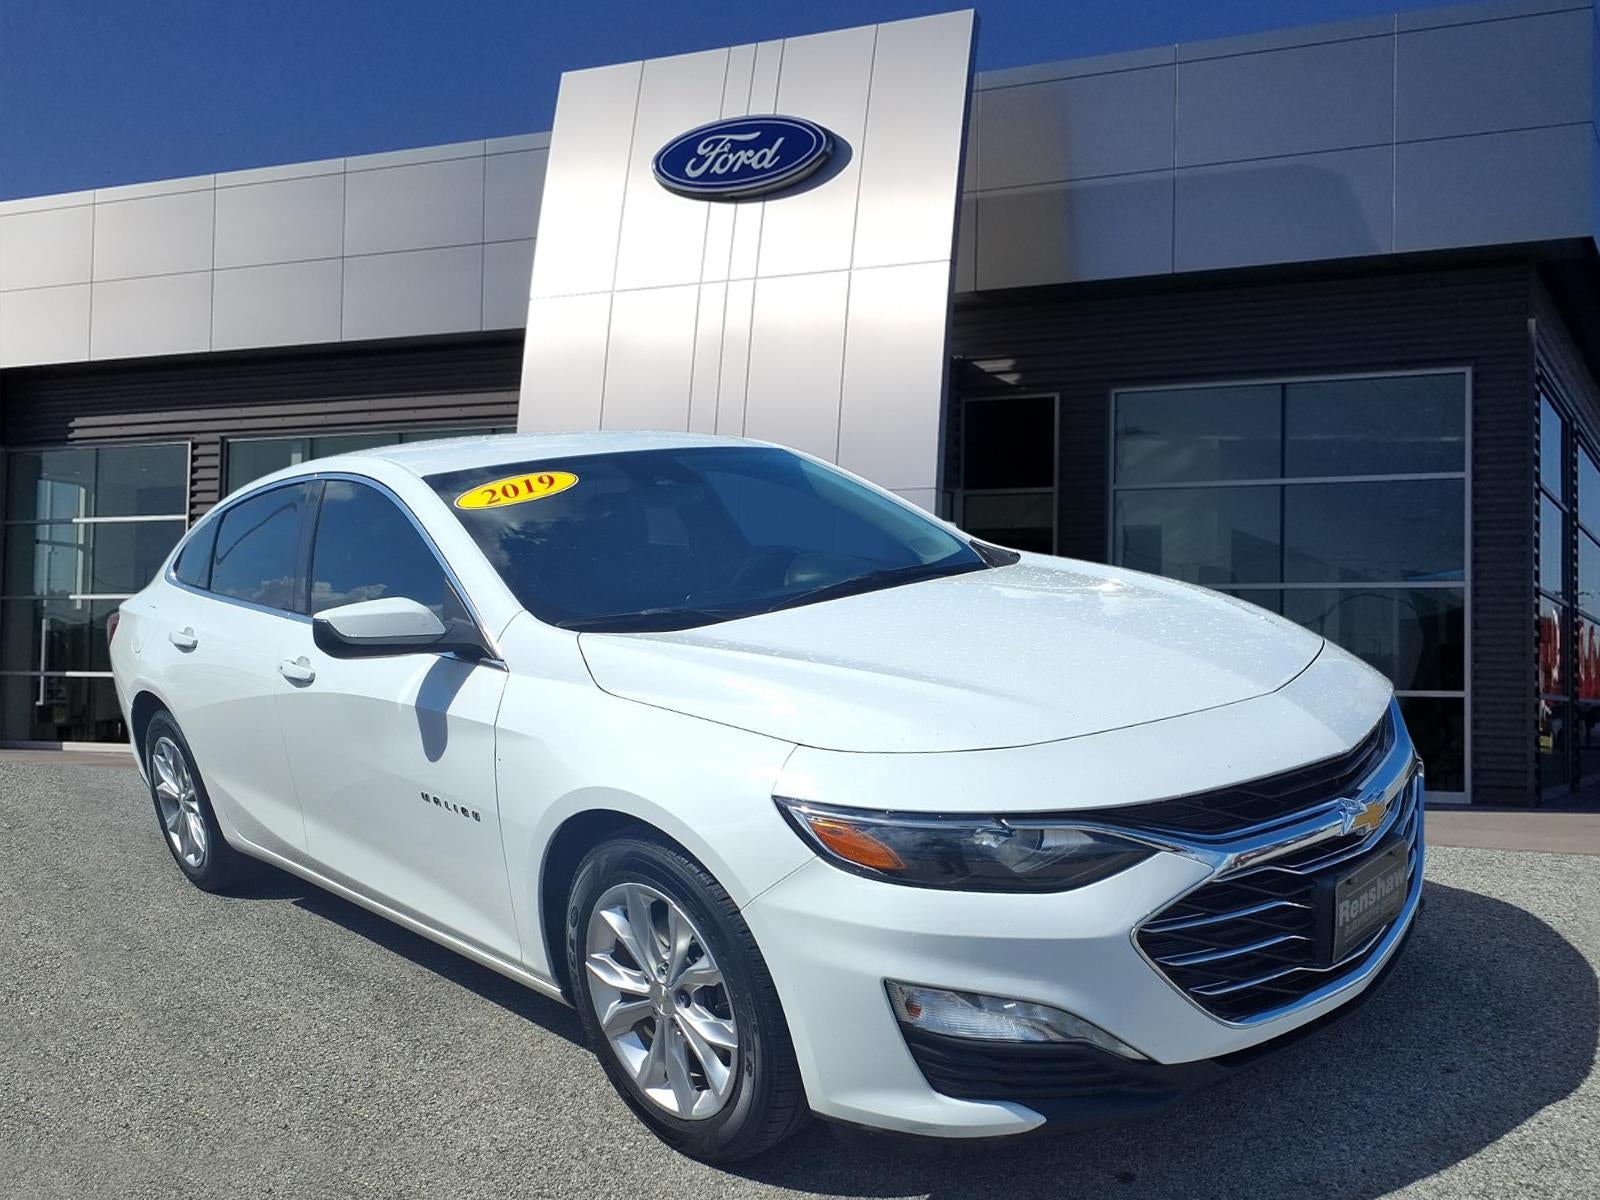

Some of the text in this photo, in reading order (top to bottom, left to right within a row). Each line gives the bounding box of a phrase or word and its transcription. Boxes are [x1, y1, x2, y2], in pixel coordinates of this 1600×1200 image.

[685, 131, 784, 178] Ford
[481, 474, 555, 505] 2019
[420, 791, 481, 822] MALIBU
